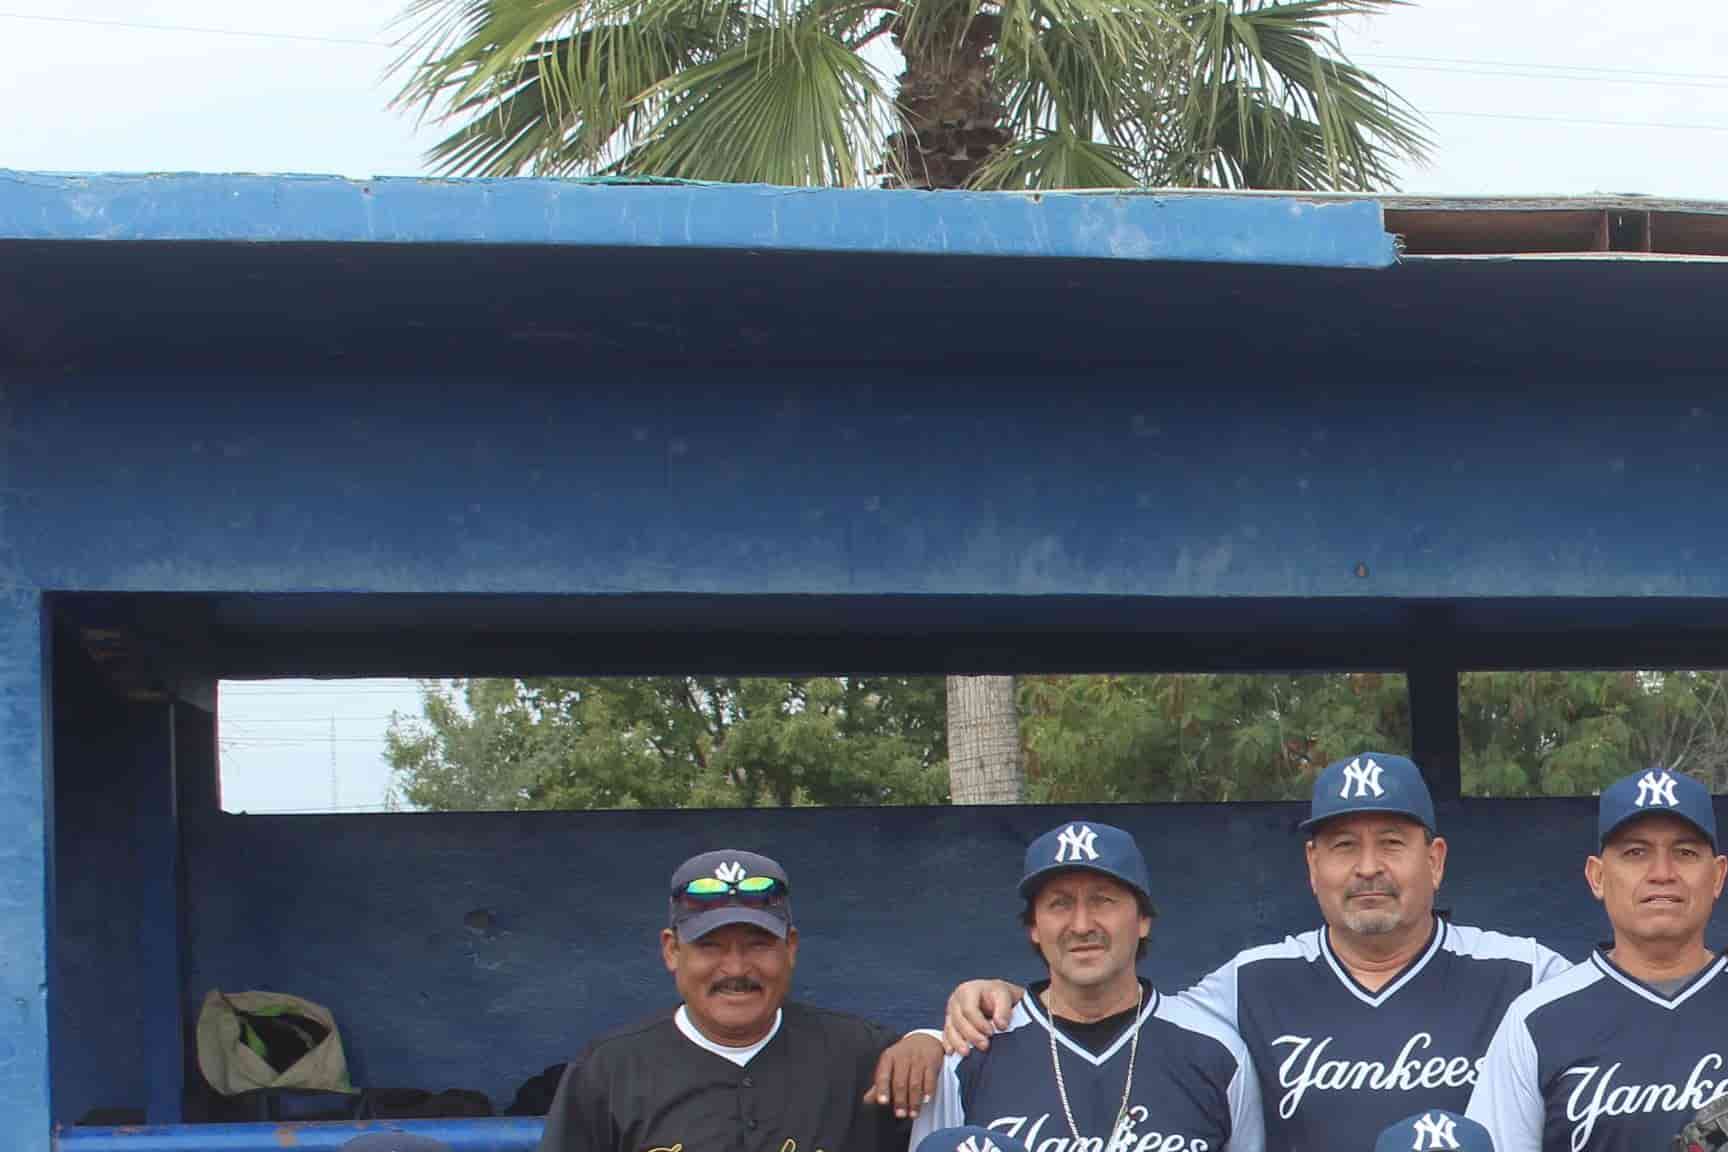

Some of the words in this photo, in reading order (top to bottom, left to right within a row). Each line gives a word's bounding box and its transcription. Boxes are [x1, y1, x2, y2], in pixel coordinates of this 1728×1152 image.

[1339, 757, 1386, 799] NY
[1634, 769, 1680, 808] NY
[1054, 825, 1100, 863] NY
[1412, 1111, 1459, 1152] NY
